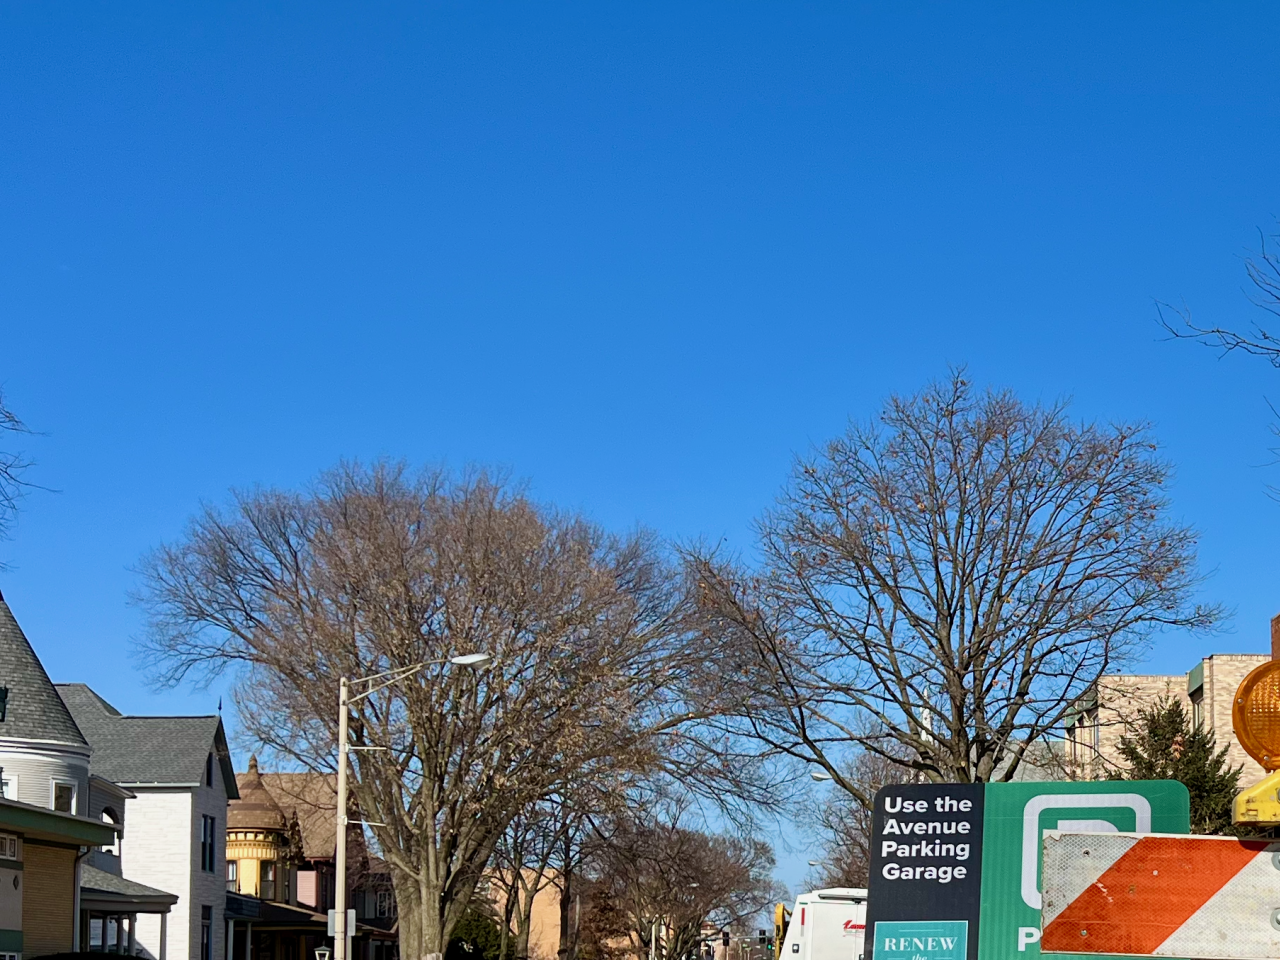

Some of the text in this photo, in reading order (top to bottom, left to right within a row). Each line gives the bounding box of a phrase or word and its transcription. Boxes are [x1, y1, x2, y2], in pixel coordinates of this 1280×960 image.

[884, 796, 972, 813] Use the
[882, 818, 971, 834] Avenue
[881, 840, 970, 860] Parking
[882, 863, 967, 883] Garage
[883, 936, 958, 951] RENEW
